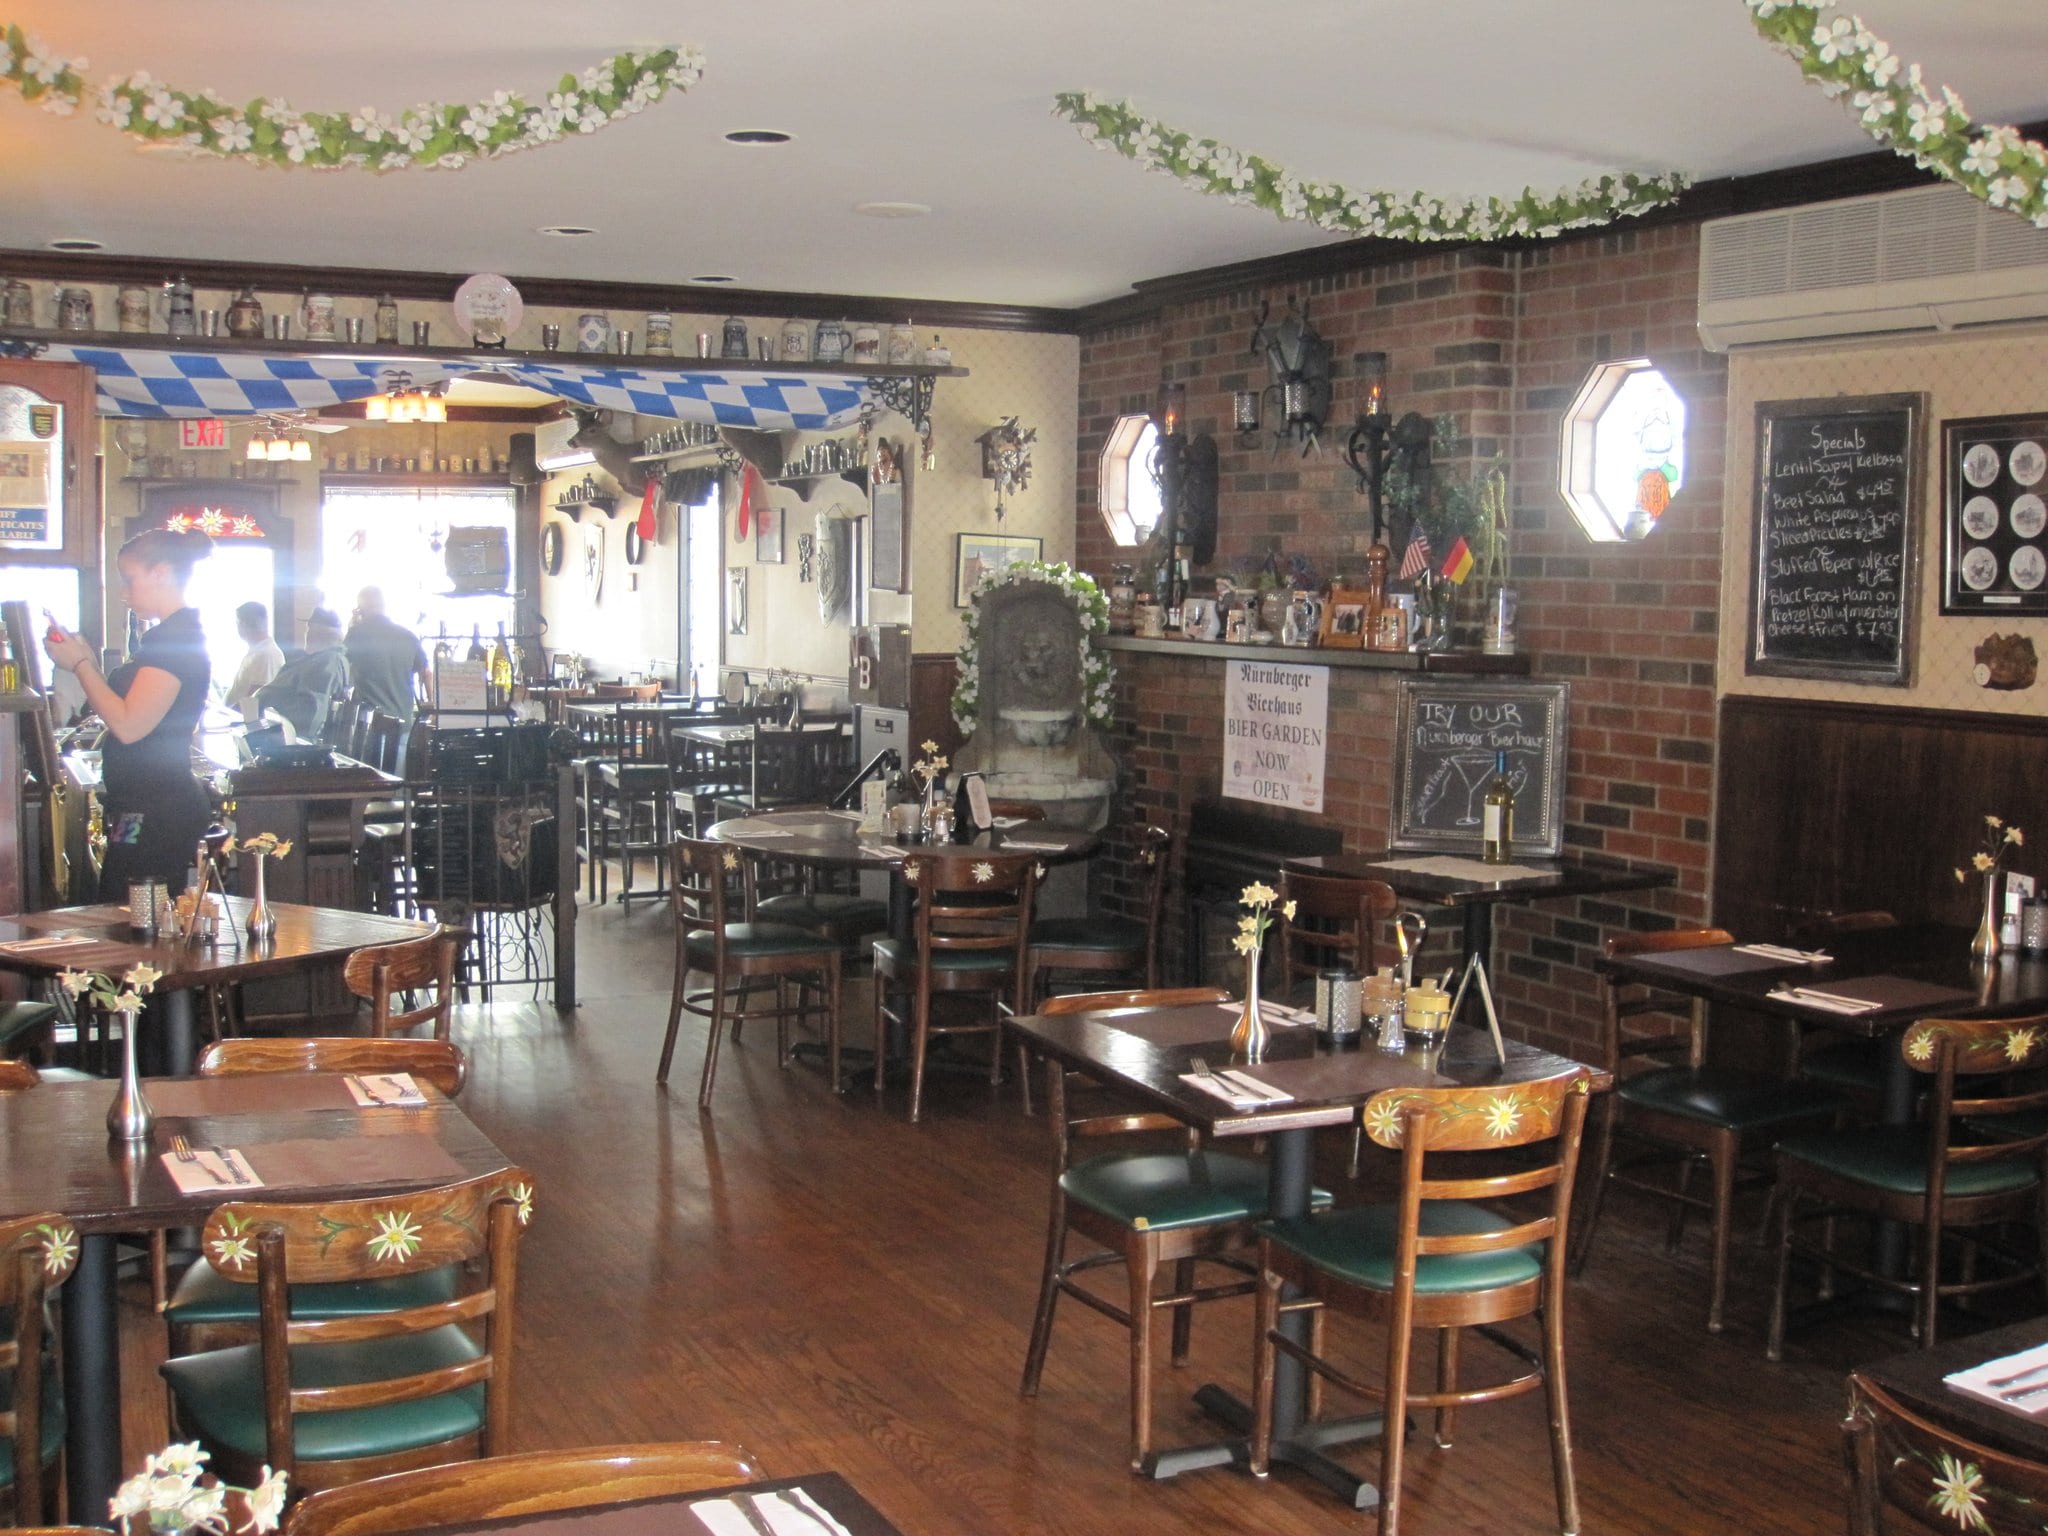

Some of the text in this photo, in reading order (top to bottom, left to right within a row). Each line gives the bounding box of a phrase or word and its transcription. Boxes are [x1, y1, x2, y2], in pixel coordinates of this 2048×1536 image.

[183, 418, 225, 447] EXIT
[1811, 425, 1866, 457] Specials
[0, 510, 17, 519] IFT
[0, 520, 45, 530] FICATES
[1774, 511, 1812, 529] White
[0, 531, 37, 540] LABLE
[1842, 586, 1873, 601] Ham
[1875, 591, 1895, 602] on
[1240, 663, 1312, 692] Nürnberger
[1247, 692, 1303, 718] Bierhaus
[1420, 703, 1522, 728] TRY OUR
[1228, 718, 1322, 747] BIER GARDEN
[1255, 750, 1290, 771] NOW
[1253, 779, 1290, 801] OPEN
